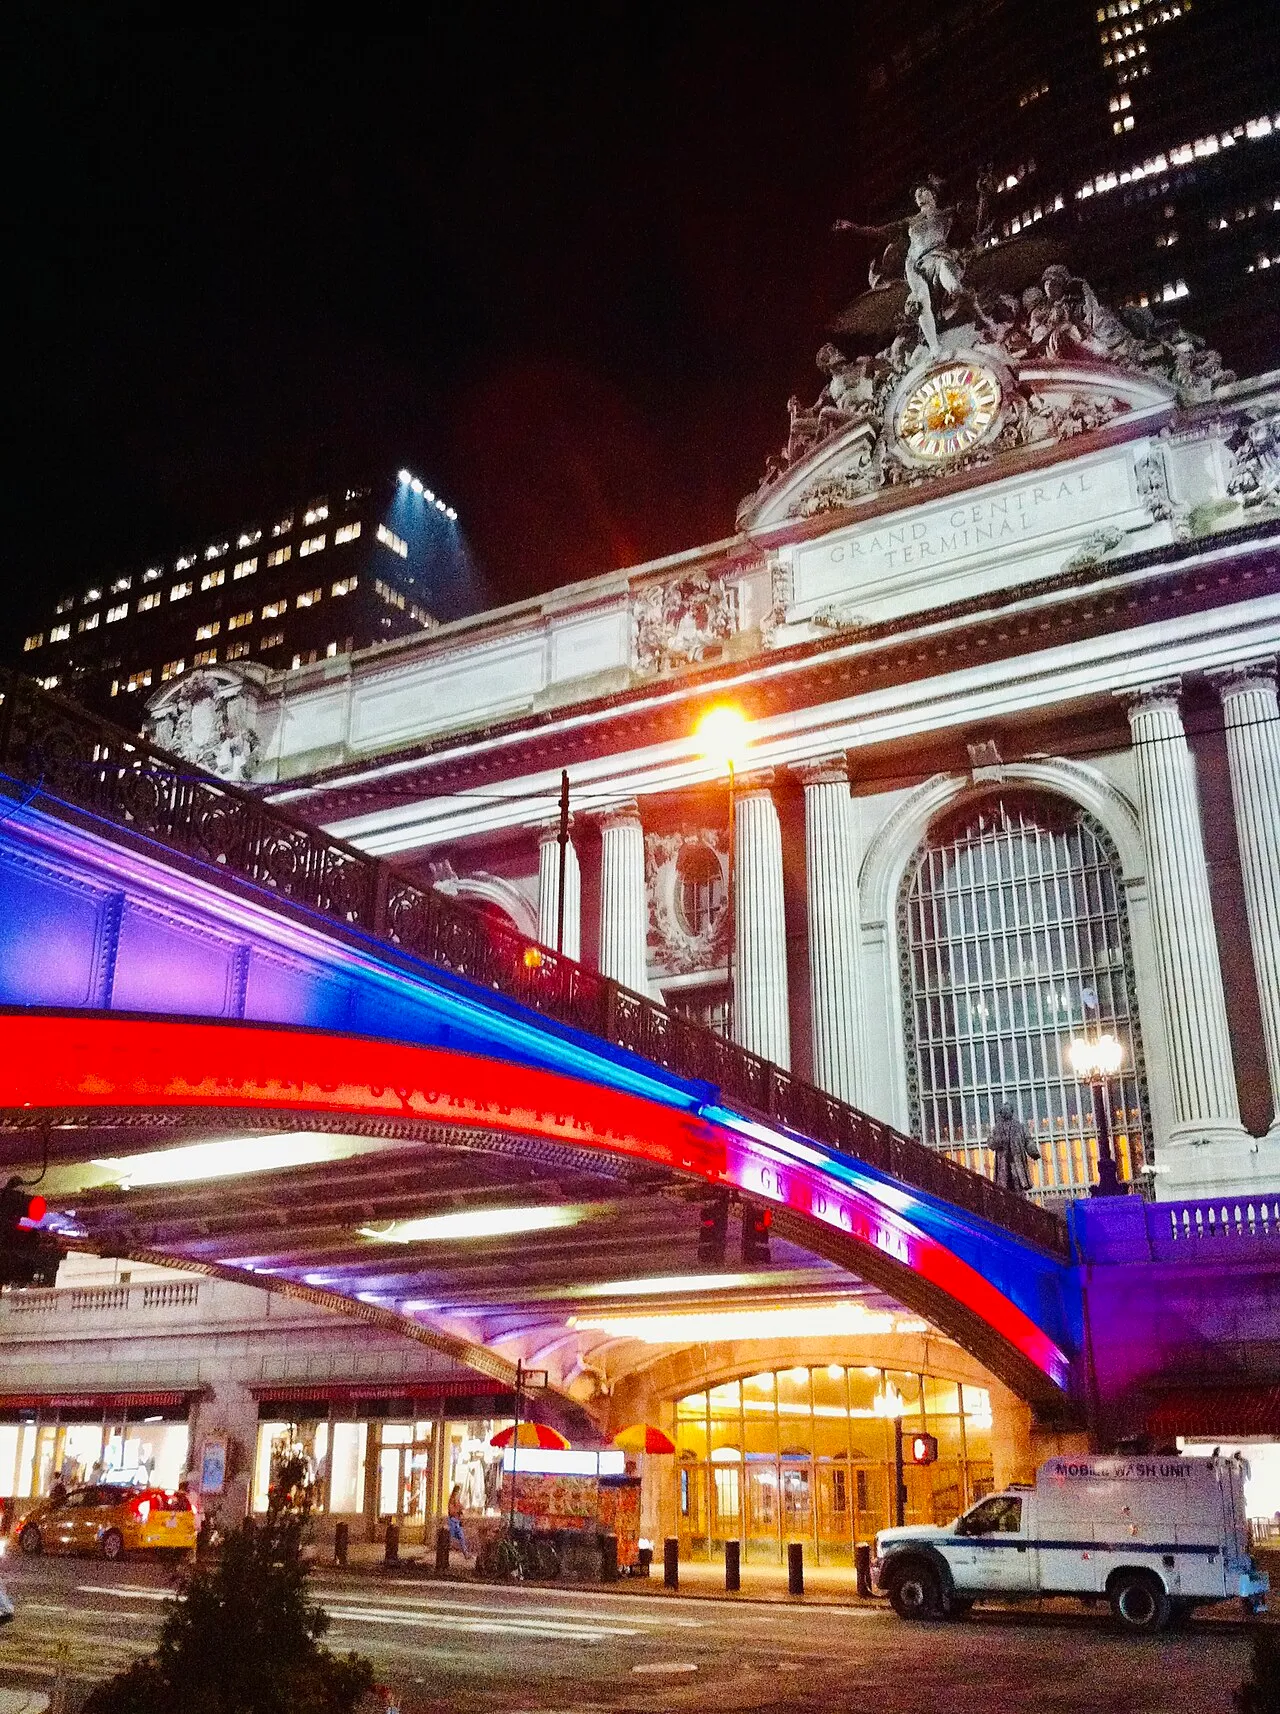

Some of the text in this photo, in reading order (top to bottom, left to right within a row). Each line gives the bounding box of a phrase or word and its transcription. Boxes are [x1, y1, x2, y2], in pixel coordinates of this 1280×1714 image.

[830, 475, 1092, 563] GRAND CENTRAL
[884, 513, 1032, 568] TERMINAL
[760, 1167, 913, 1265] GRD CTRAL
[1055, 1463, 1110, 1477] MOBI
[1160, 1464, 1193, 1477] UNIT
